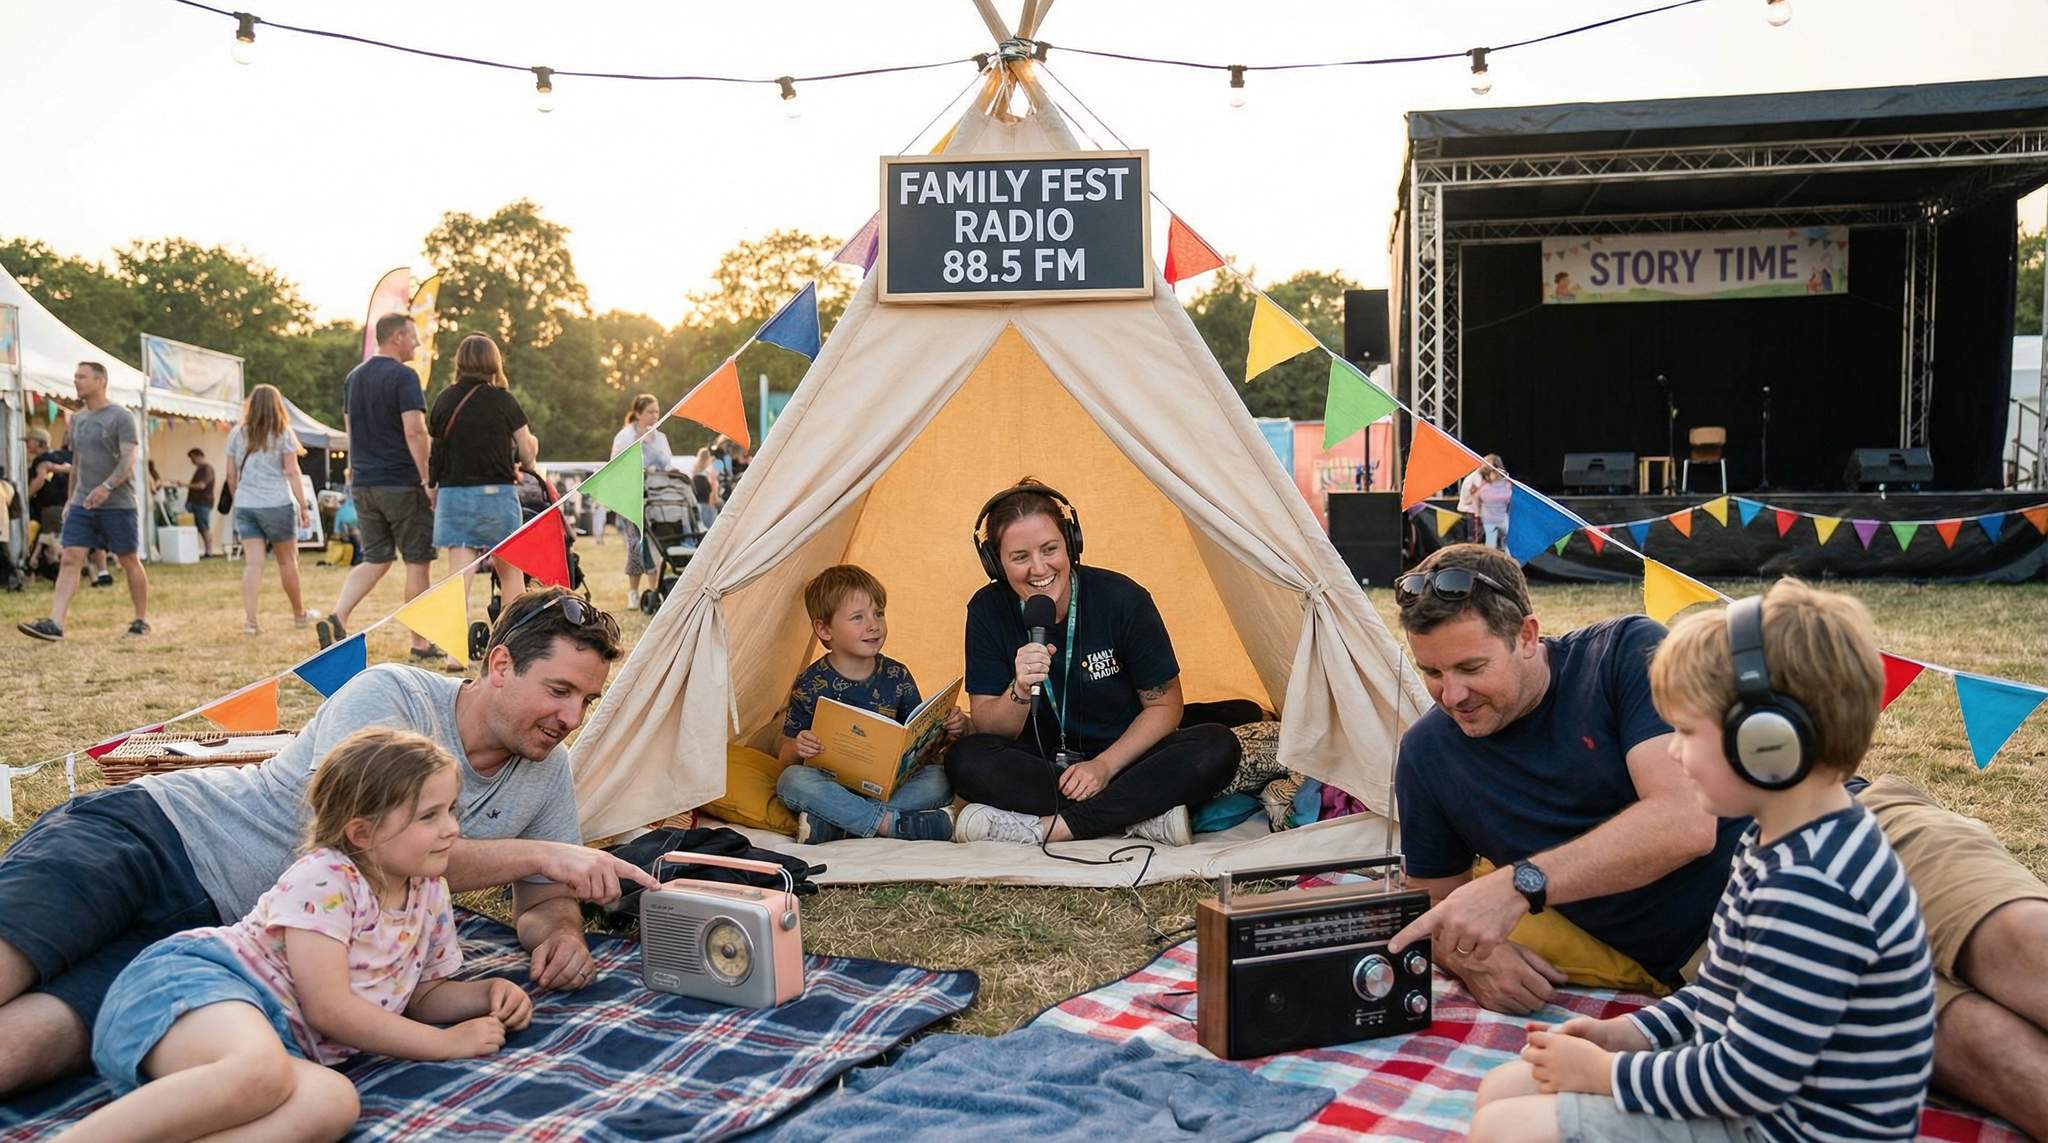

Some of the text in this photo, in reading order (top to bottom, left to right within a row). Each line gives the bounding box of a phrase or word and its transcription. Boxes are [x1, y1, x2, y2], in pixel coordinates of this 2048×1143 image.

[899, 167, 1129, 205] FAMILY FEST
[955, 207, 1074, 243] RADIO
[942, 247, 1086, 284] 88.5 FM
[1589, 244, 1799, 286] STORY TIME
